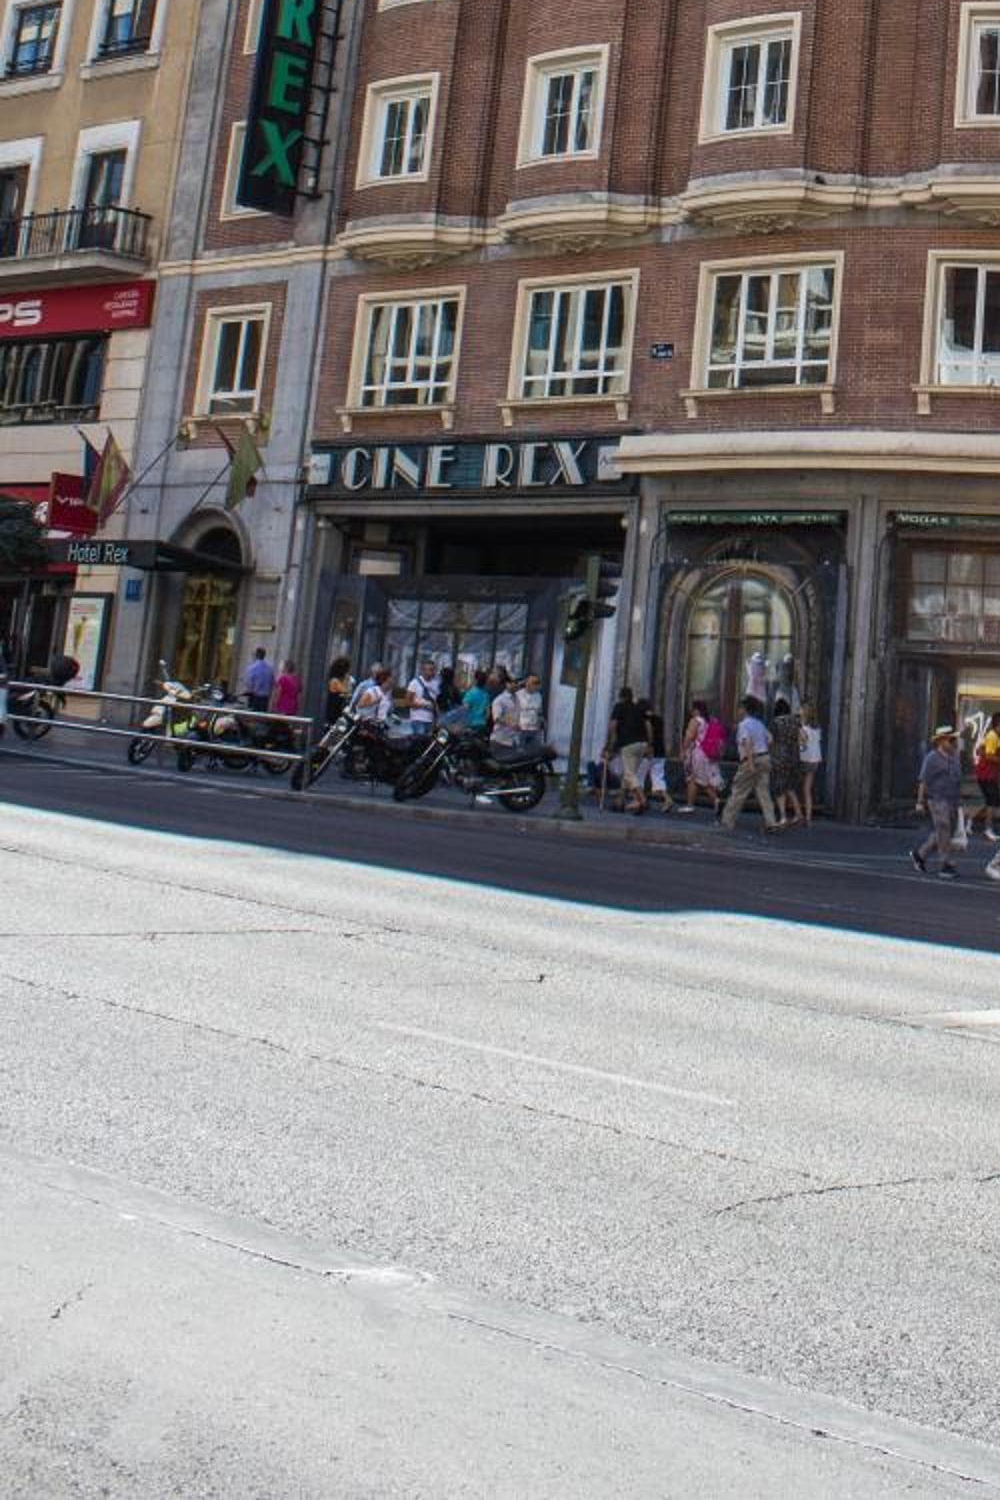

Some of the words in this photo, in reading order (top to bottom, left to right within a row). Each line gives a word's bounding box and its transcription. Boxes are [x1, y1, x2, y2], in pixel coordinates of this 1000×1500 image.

[341, 444, 456, 491] CINE
[482, 440, 587, 488] REX
[67, 542, 101, 563] Hotel
[104, 543, 129, 563] Rex
